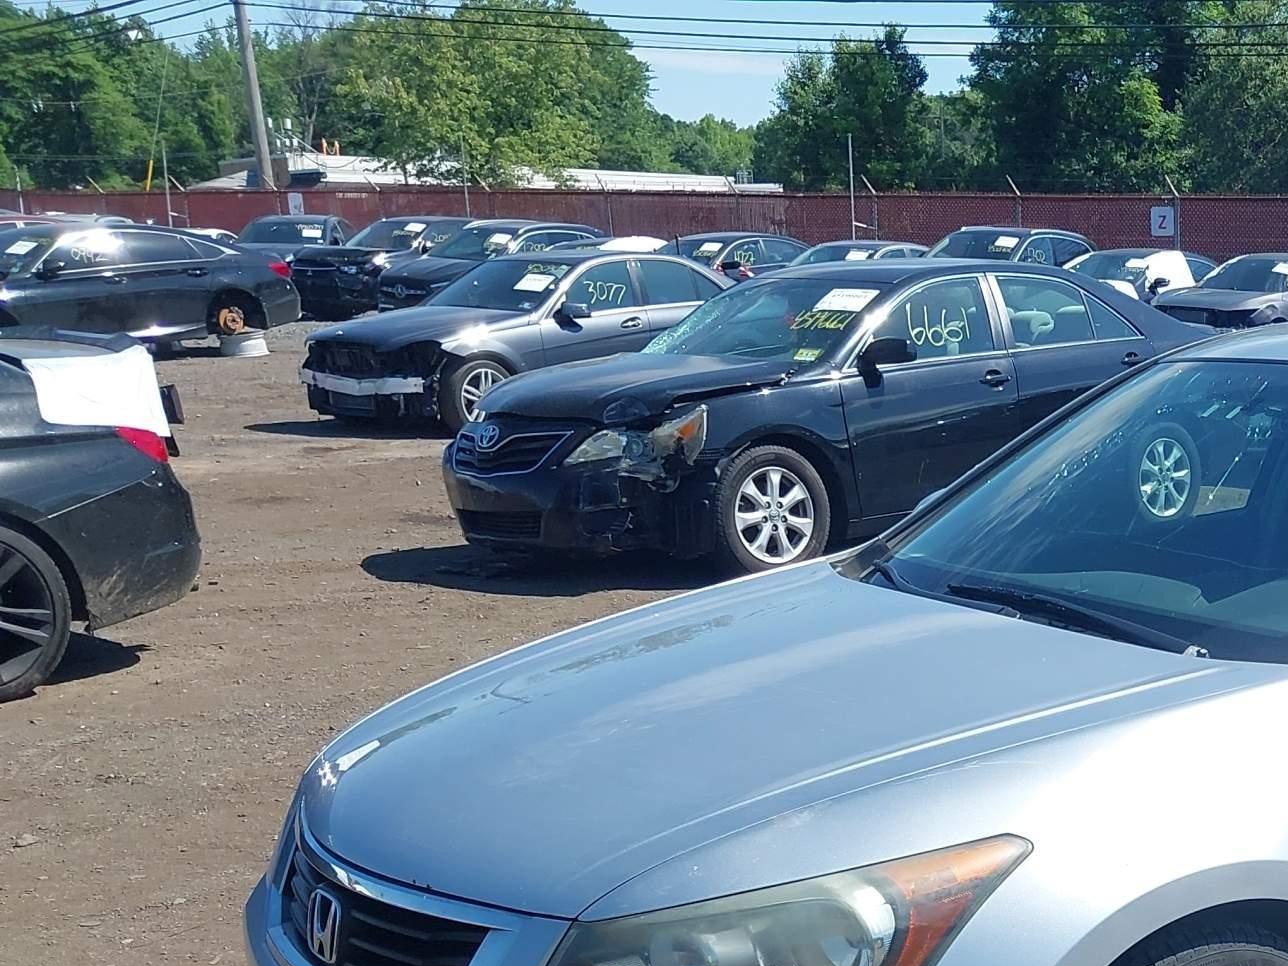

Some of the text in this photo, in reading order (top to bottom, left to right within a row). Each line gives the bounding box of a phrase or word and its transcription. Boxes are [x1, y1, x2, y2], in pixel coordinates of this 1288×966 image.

[1158, 215, 1167, 230] Z
[583, 280, 626, 305] 3077
[905, 302, 970, 347] 6661
